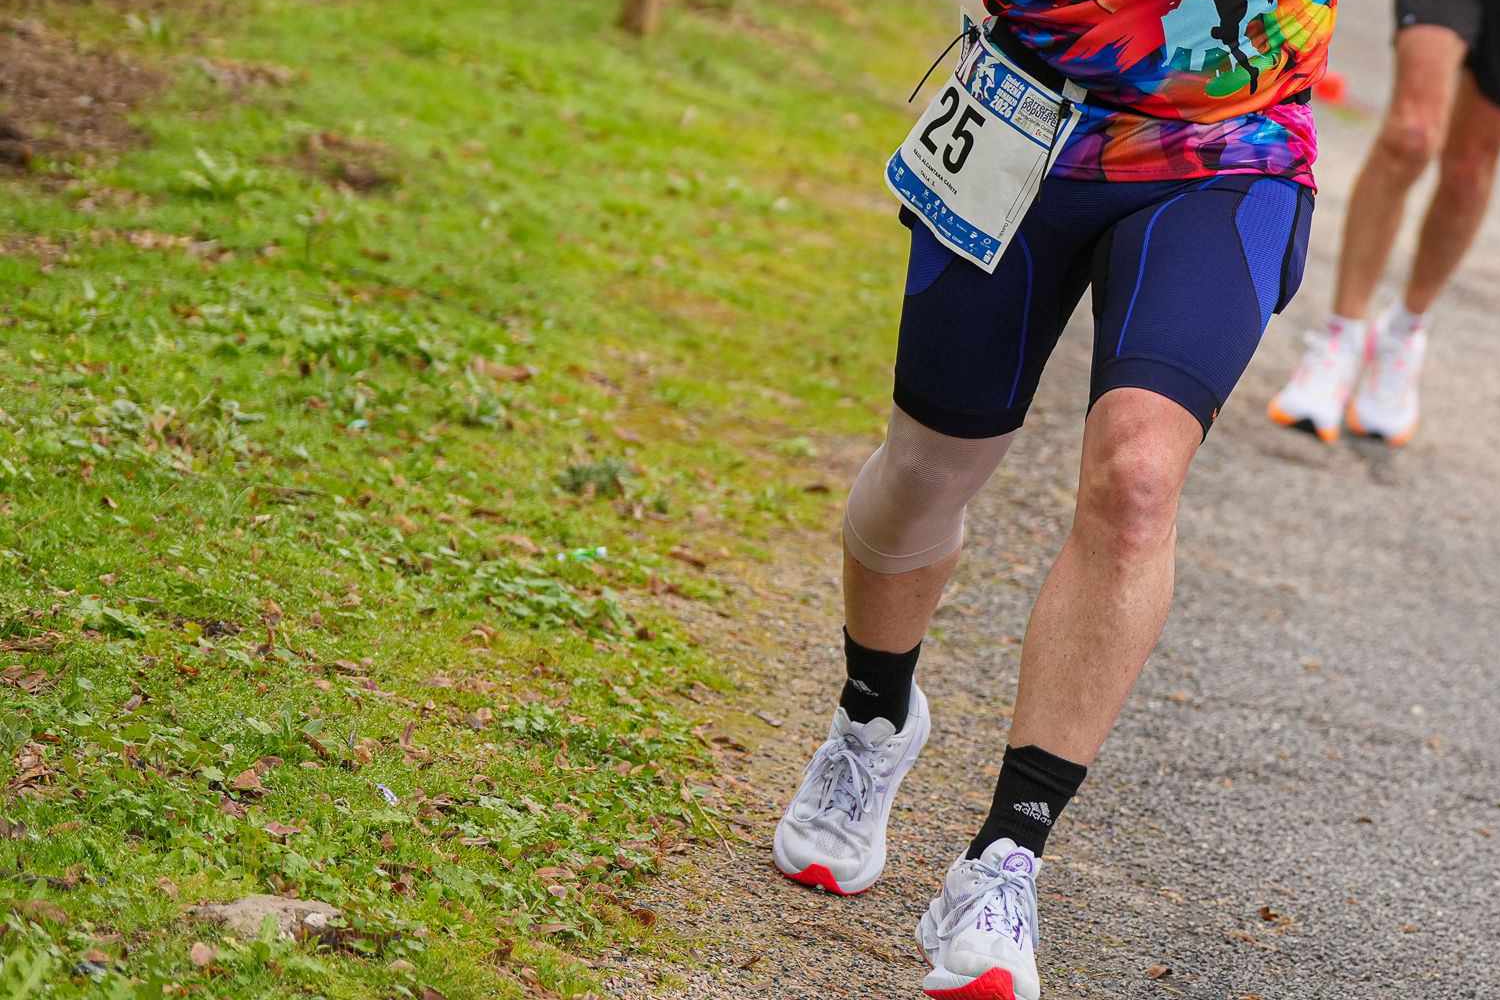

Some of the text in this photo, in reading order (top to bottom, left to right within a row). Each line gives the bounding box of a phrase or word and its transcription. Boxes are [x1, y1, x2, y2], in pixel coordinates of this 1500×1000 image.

[1000, 79, 1023, 100] LUCENA
[989, 94, 1014, 119] 2026
[1021, 101, 1058, 128] populare
[1025, 96, 1058, 120] carreras
[919, 86, 987, 175] 25
[920, 169, 930, 182] TALLA
[921, 158, 944, 182] ALCANTARA
